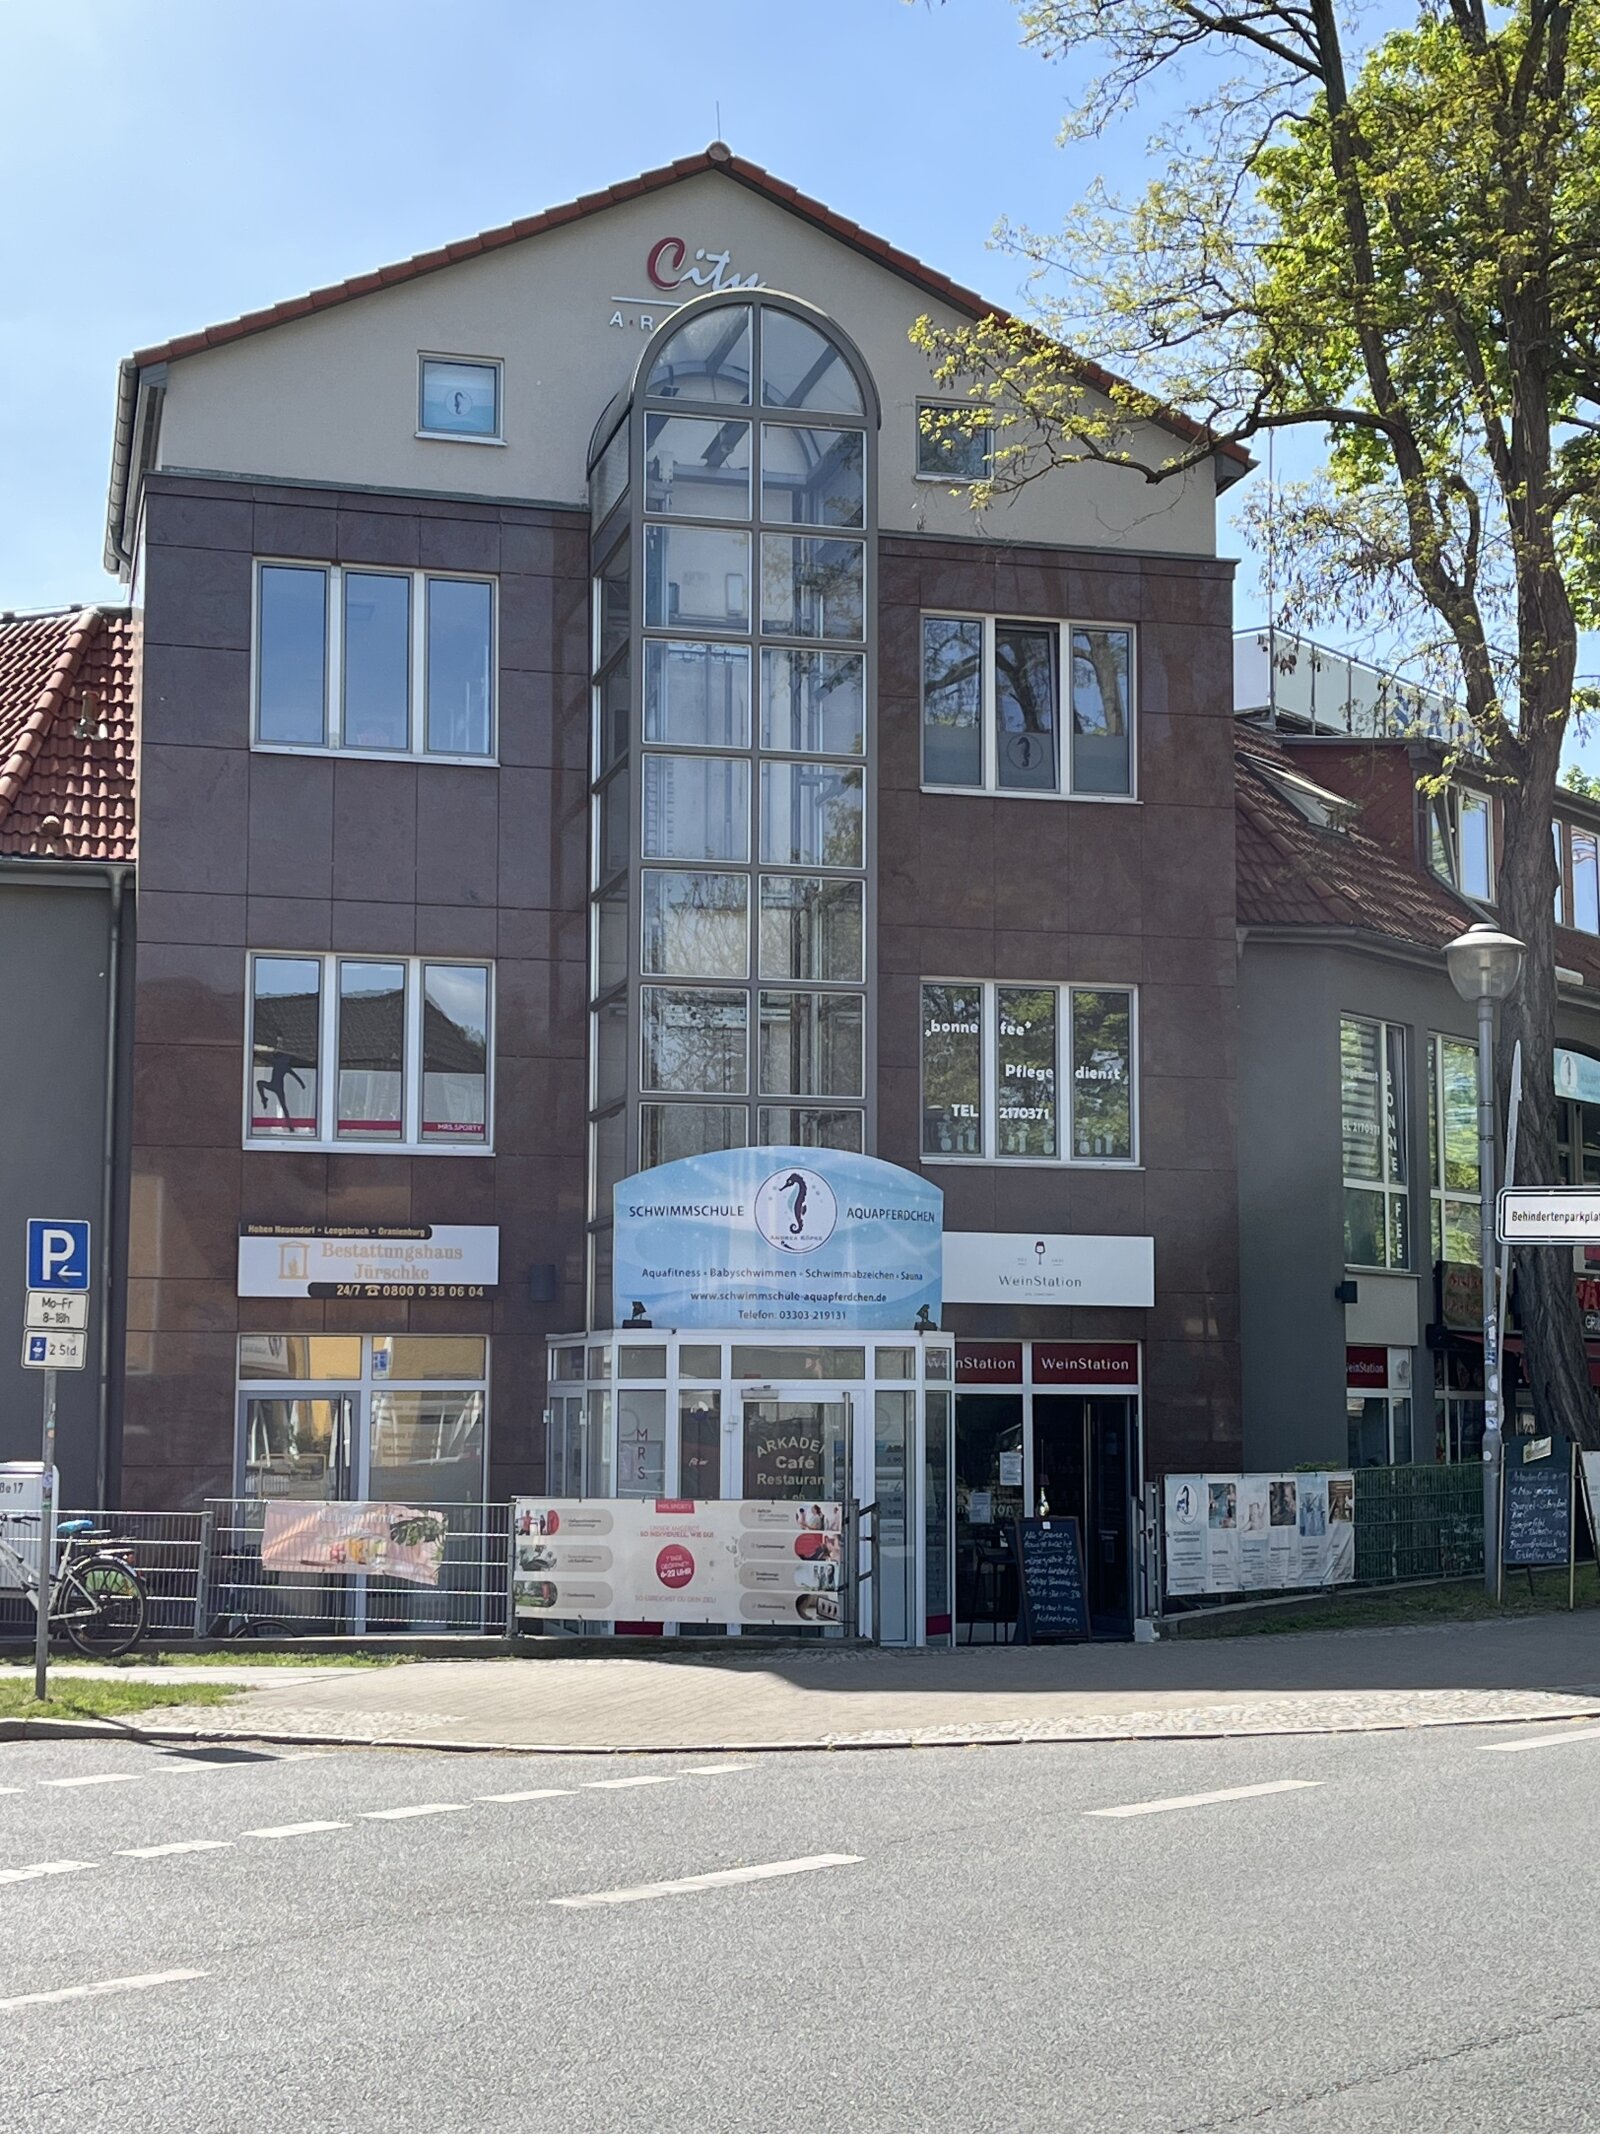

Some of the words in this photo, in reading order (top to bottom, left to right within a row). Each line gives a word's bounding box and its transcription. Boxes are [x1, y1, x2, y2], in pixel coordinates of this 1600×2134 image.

[1005, 1064, 1054, 1081] Pflege
[1075, 1066, 1121, 1080] dienst
[951, 1104, 979, 1118] TEL
[999, 1107, 1049, 1120] 2170371
[629, 1204, 745, 1217] SCHWIMMSCHULE
[846, 1207, 935, 1223] AQUAPFERDCHEN
[248, 1225, 273, 1234] Hohen
[275, 1225, 315, 1235] Neuendorf
[378, 1227, 425, 1238] Oranienburg
[1395, 1202, 1403, 1260] FEE
[42, 1229, 75, 1281] P
[321, 1241, 463, 1262] Bestattungshaus
[354, 1263, 429, 1280] Jürschke
[641, 1268, 701, 1280] Aquafitness
[709, 1267, 797, 1279] Babyschwimmen
[805, 1269, 894, 1280] Schwimmabzeichen
[900, 1272, 923, 1281] Sauna
[999, 1275, 1082, 1288] WeinStation
[336, 1284, 360, 1296] 24/7
[383, 1285, 414, 1296] 0800
[418, 1285, 426, 1296] 0
[430, 1286, 445, 1297] 38
[449, 1286, 464, 1297] 06
[468, 1286, 484, 1297] 04
[690, 1291, 887, 1304] www.schwimmschule-aquapferdchen.de
[739, 1310, 777, 1320] Telefon:
[779, 1309, 847, 1320] 03303-219131
[49, 1345, 55, 1355] 2
[59, 1345, 78, 1356] Std.
[927, 1357, 1015, 1370] WenStation
[1041, 1357, 1129, 1370] WeinStation
[776, 1456, 815, 1469] Café
[14, 1482, 23, 1494] 17
